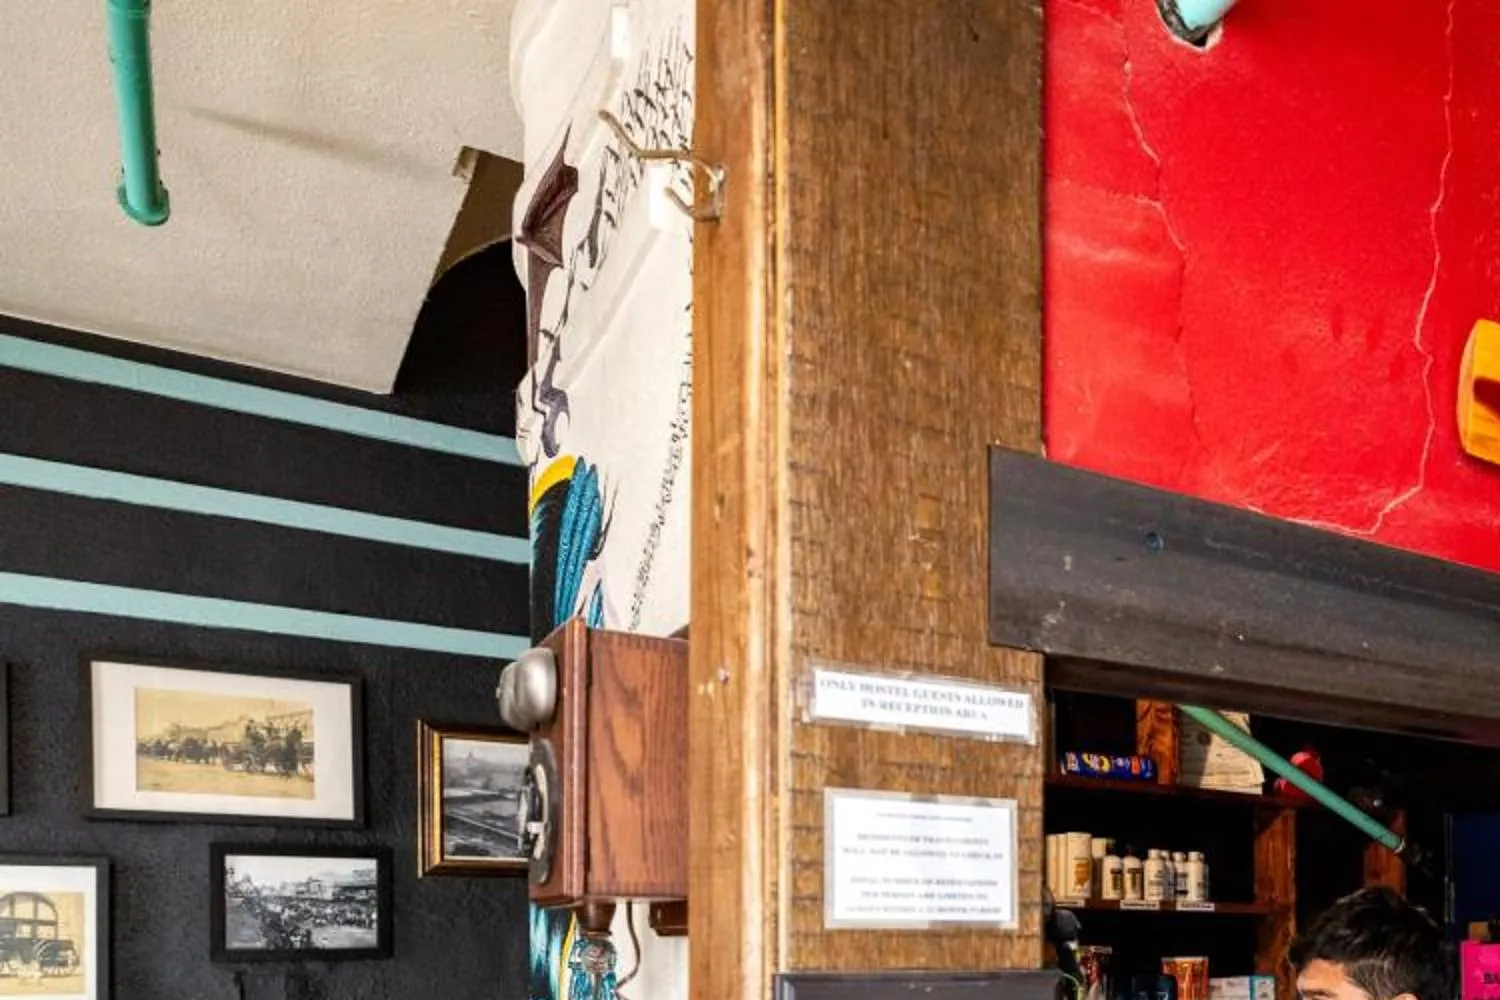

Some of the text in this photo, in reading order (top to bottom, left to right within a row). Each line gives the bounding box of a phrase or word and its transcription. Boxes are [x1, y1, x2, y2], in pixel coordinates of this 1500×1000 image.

[820, 679, 1024, 709] ONLY HOSTEL GUESTS ALLOWED
